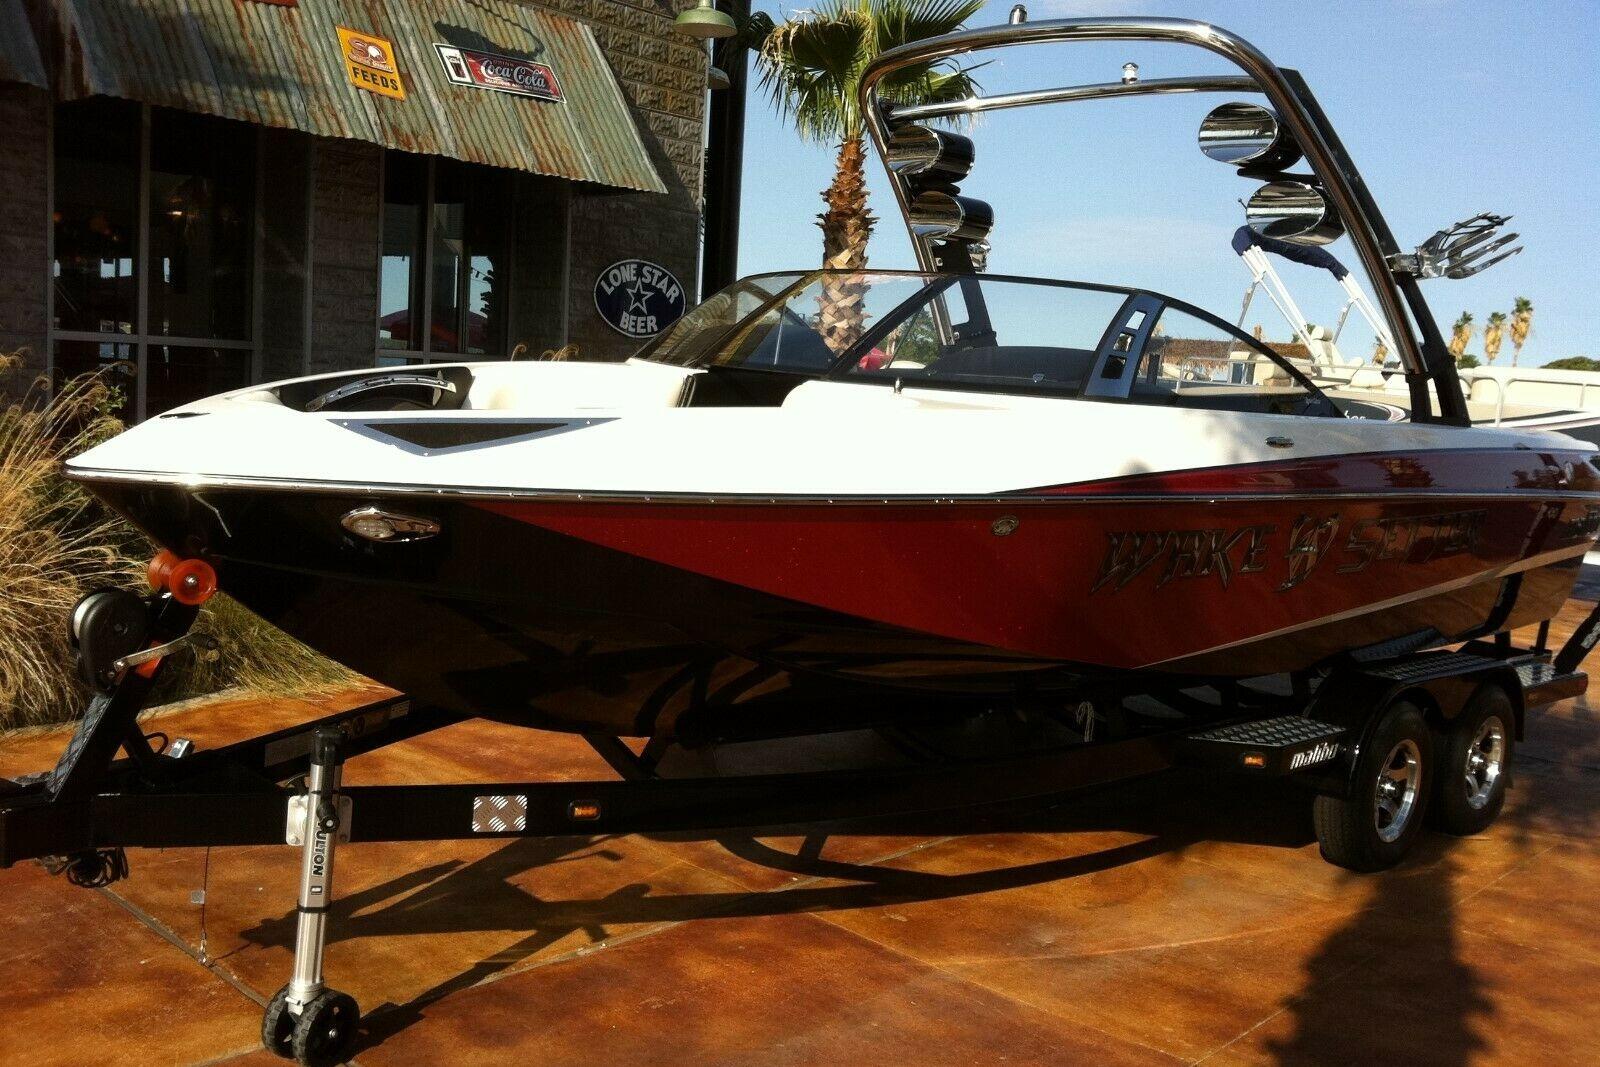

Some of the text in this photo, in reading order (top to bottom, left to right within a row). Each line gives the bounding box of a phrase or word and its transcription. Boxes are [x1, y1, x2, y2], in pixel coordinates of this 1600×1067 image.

[352, 66, 399, 91] FEEDS
[600, 264, 680, 304] LONE STAR
[620, 311, 659, 334] BEER
[1089, 524, 1278, 594] WAKE
[1289, 742, 1340, 770] malibu
[313, 821, 328, 877] ULTON
